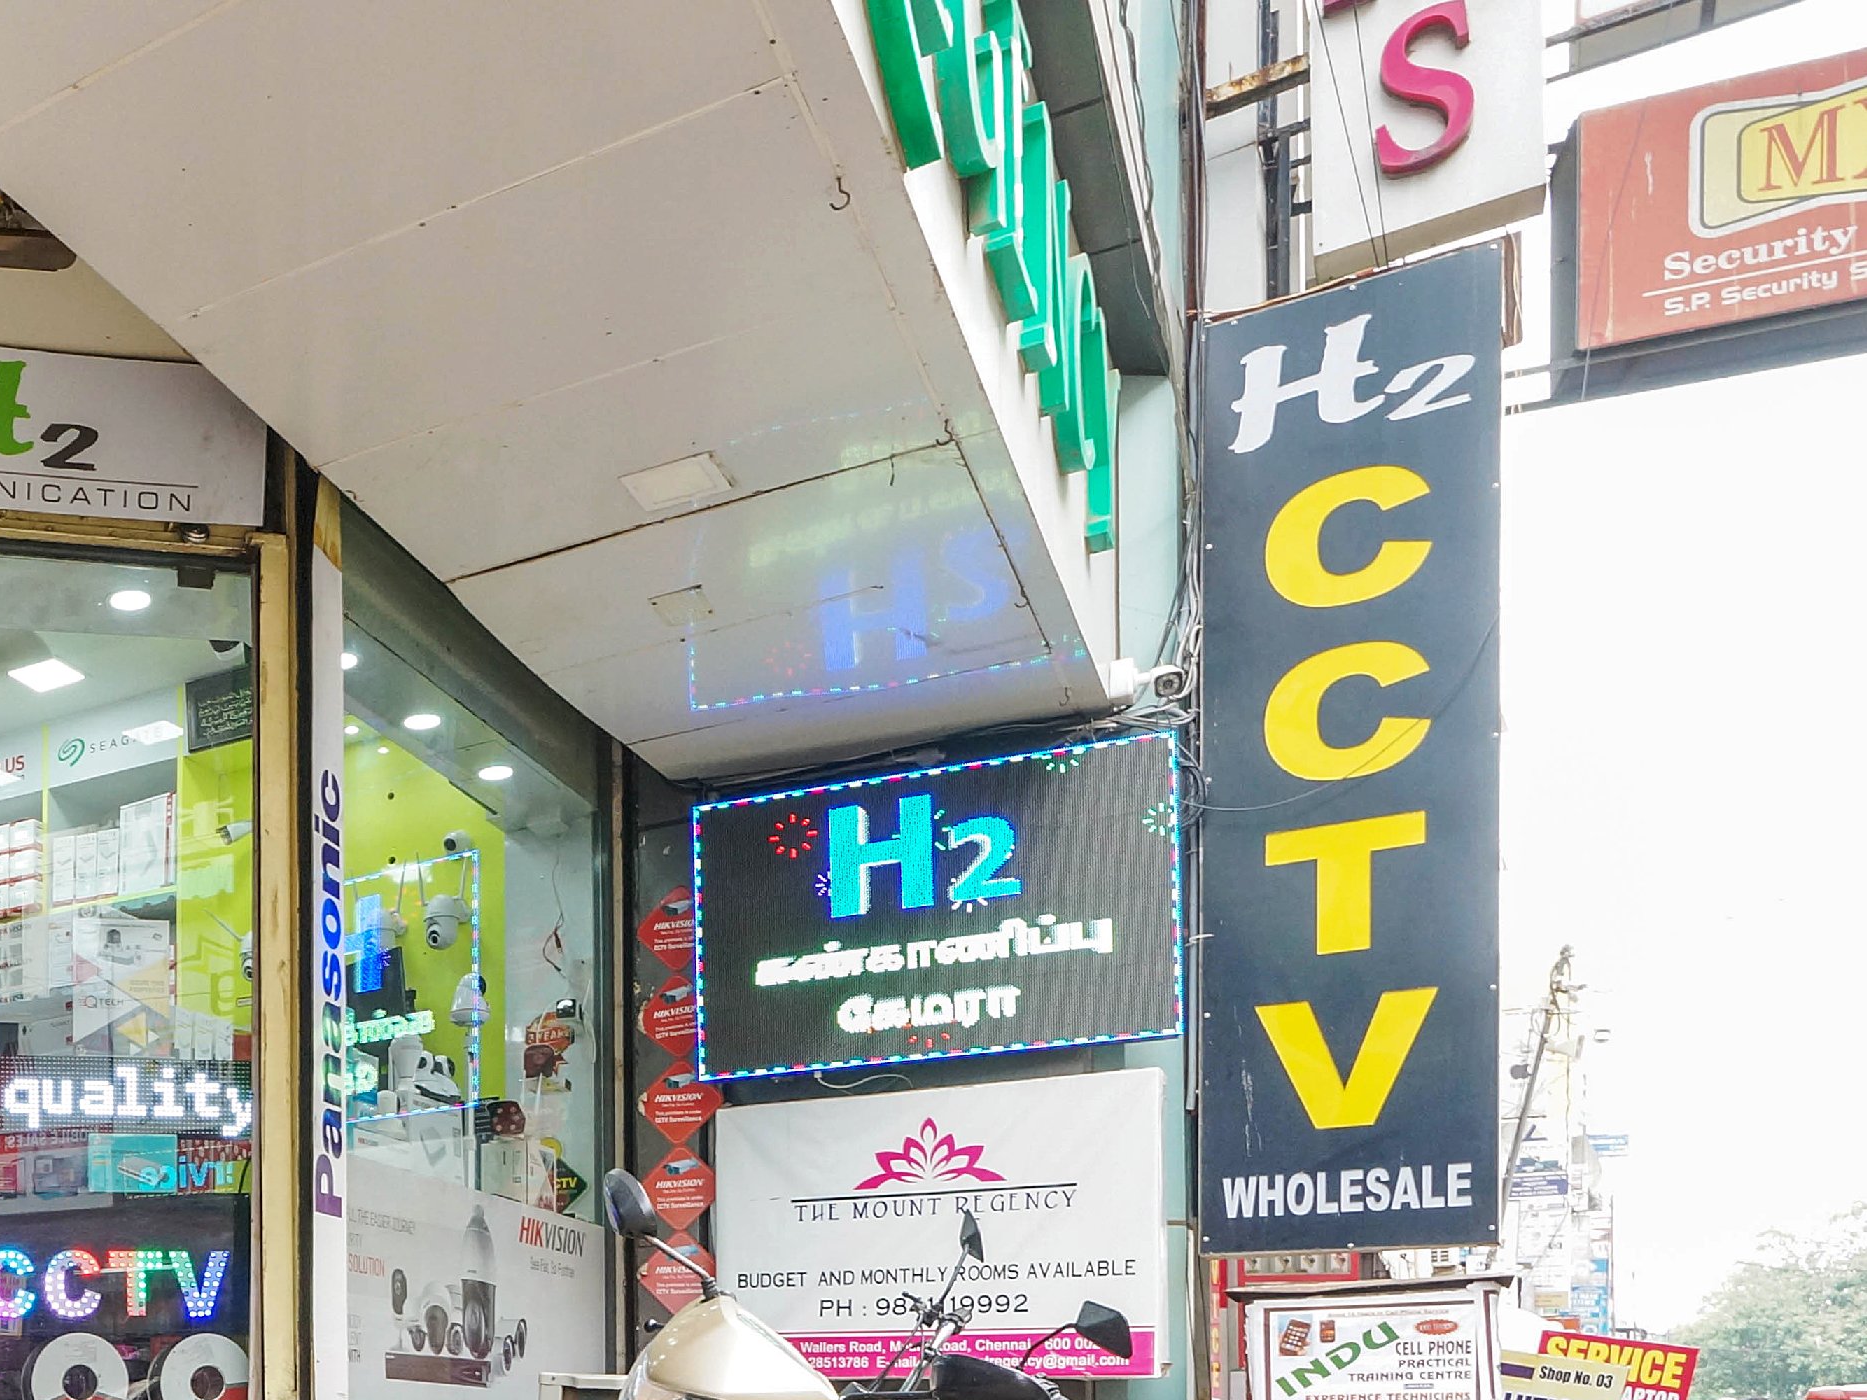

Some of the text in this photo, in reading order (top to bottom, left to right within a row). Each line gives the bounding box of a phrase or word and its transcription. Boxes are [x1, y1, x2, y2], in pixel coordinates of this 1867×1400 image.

[1757, 98, 1867, 192] M
[1663, 225, 1858, 281] Security
[1721, 270, 1838, 306] Security
[827, 793, 1023, 919] H2
[313, 768, 344, 1220] Panasonic
[3, 1065, 252, 1139] quality
[654, 1093, 703, 1103] HIKVISION
[655, 1178, 705, 1189] HIKVISION
[1221, 1161, 1474, 1222] WHOLESALE
[795, 1189, 1078, 1223] THE MOUNT REGENCY
[518, 1214, 586, 1258] HIKVISION
[736, 1259, 1137, 1290] BUDGET AND MONTHLY ROOMS AVAILABLE
[819, 1298, 853, 1318] PH
[800, 1339, 847, 1354] Wallers
[849, 1338, 886, 1354] Road,
[939, 1338, 972, 1354] oad,
[974, 1337, 1032, 1353] Chennai
[1045, 1337, 1071, 1351] 600
[1274, 1320, 1400, 1398] INDU
[1395, 1340, 1472, 1356] CELL PHONE
[1347, 1370, 1472, 1383] TRAINING CENTRE
[1398, 1358, 1472, 1369] PRACTICAL
[1538, 1365, 1614, 1389] Shop No. 03
